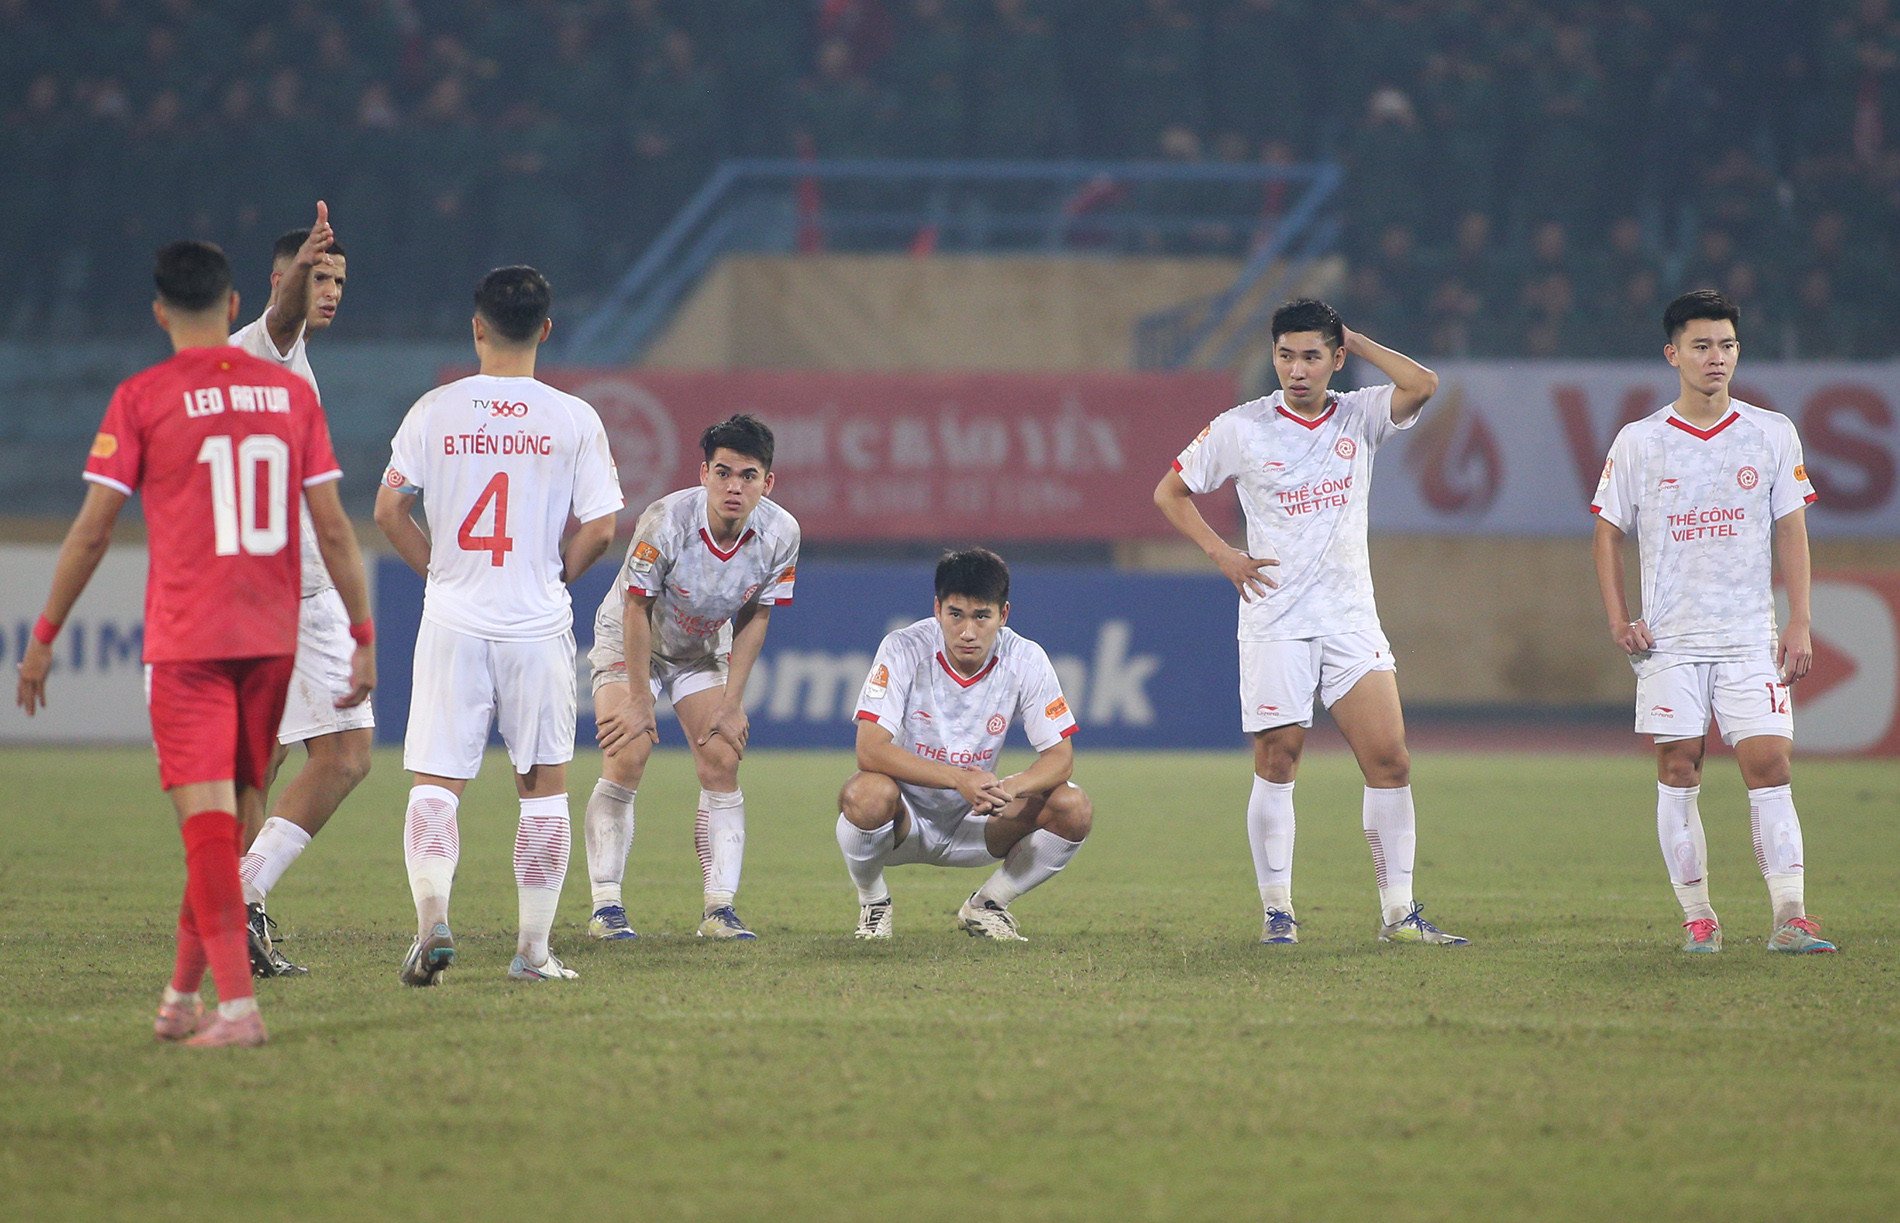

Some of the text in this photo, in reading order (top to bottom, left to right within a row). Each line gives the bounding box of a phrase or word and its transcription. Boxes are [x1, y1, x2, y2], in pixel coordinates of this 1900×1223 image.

[183, 385, 291, 418] LEO ARTUR
[472, 399, 528, 417] TV360
[444, 423, 551, 455] B.TIẾN DŨNG
[197, 434, 289, 556] 10
[1276, 475, 1353, 503] THỂ CÔNG
[1284, 494, 1349, 516] VIETTEL
[1667, 506, 1745, 527] THỂ CÔNG
[457, 471, 513, 567] 4
[1671, 524, 1738, 542] VIETTEL
[915, 742, 993, 764] THỂ CÔNG
